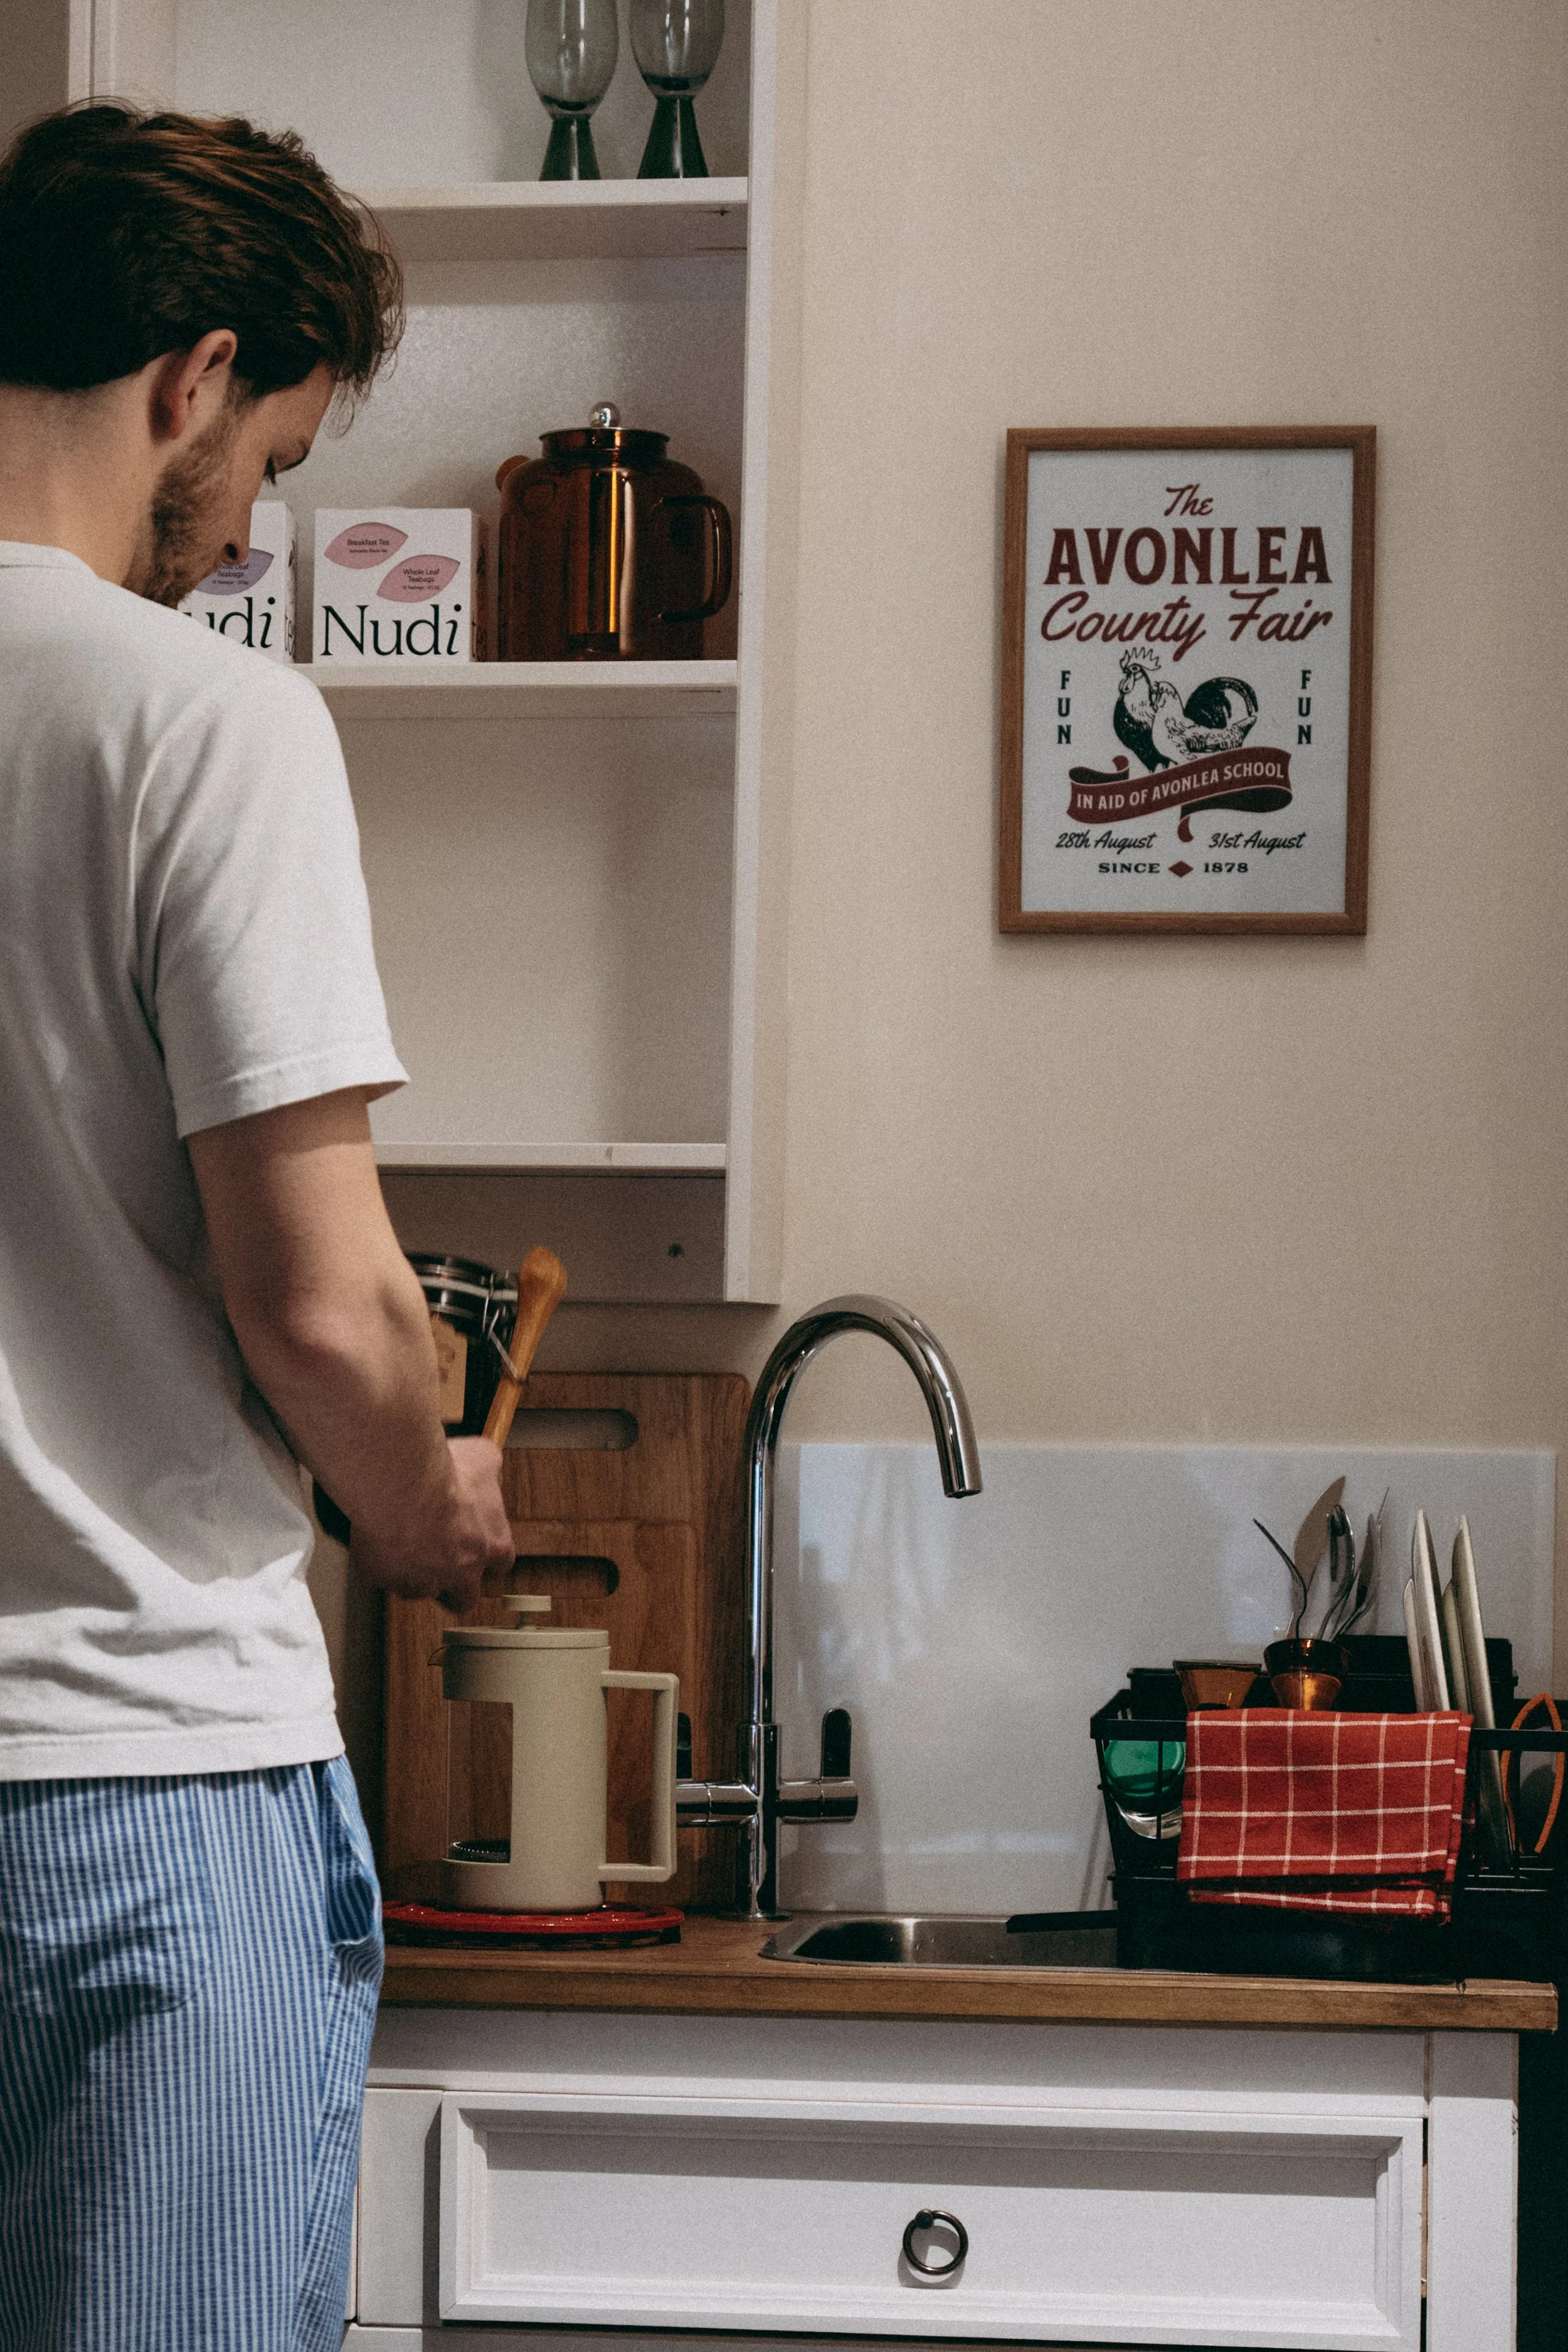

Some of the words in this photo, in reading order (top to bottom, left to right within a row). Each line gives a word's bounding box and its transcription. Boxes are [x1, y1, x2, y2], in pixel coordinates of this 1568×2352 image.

[1163, 484, 1214, 517] The
[1043, 526, 1333, 586] AVONLEA
[321, 603, 462, 656] Nudi
[1041, 590, 1207, 662] County
[1228, 587, 1333, 642] Fair
[1057, 670, 1071, 744] FUN
[1298, 669, 1311, 745] FUN
[1077, 793, 1093, 809] IN
[1098, 793, 1125, 810] AID
[1129, 788, 1148, 807] OF
[1152, 768, 1219, 802] AVONLEA
[1223, 761, 1285, 780] SCHOOL
[1056, 829, 1091, 849] 28th
[1094, 830, 1157, 855] August
[1208, 832, 1243, 849] 31st
[1243, 830, 1307, 856] August
[1098, 862, 1160, 874] SINCE
[1204, 862, 1249, 873] 1878
